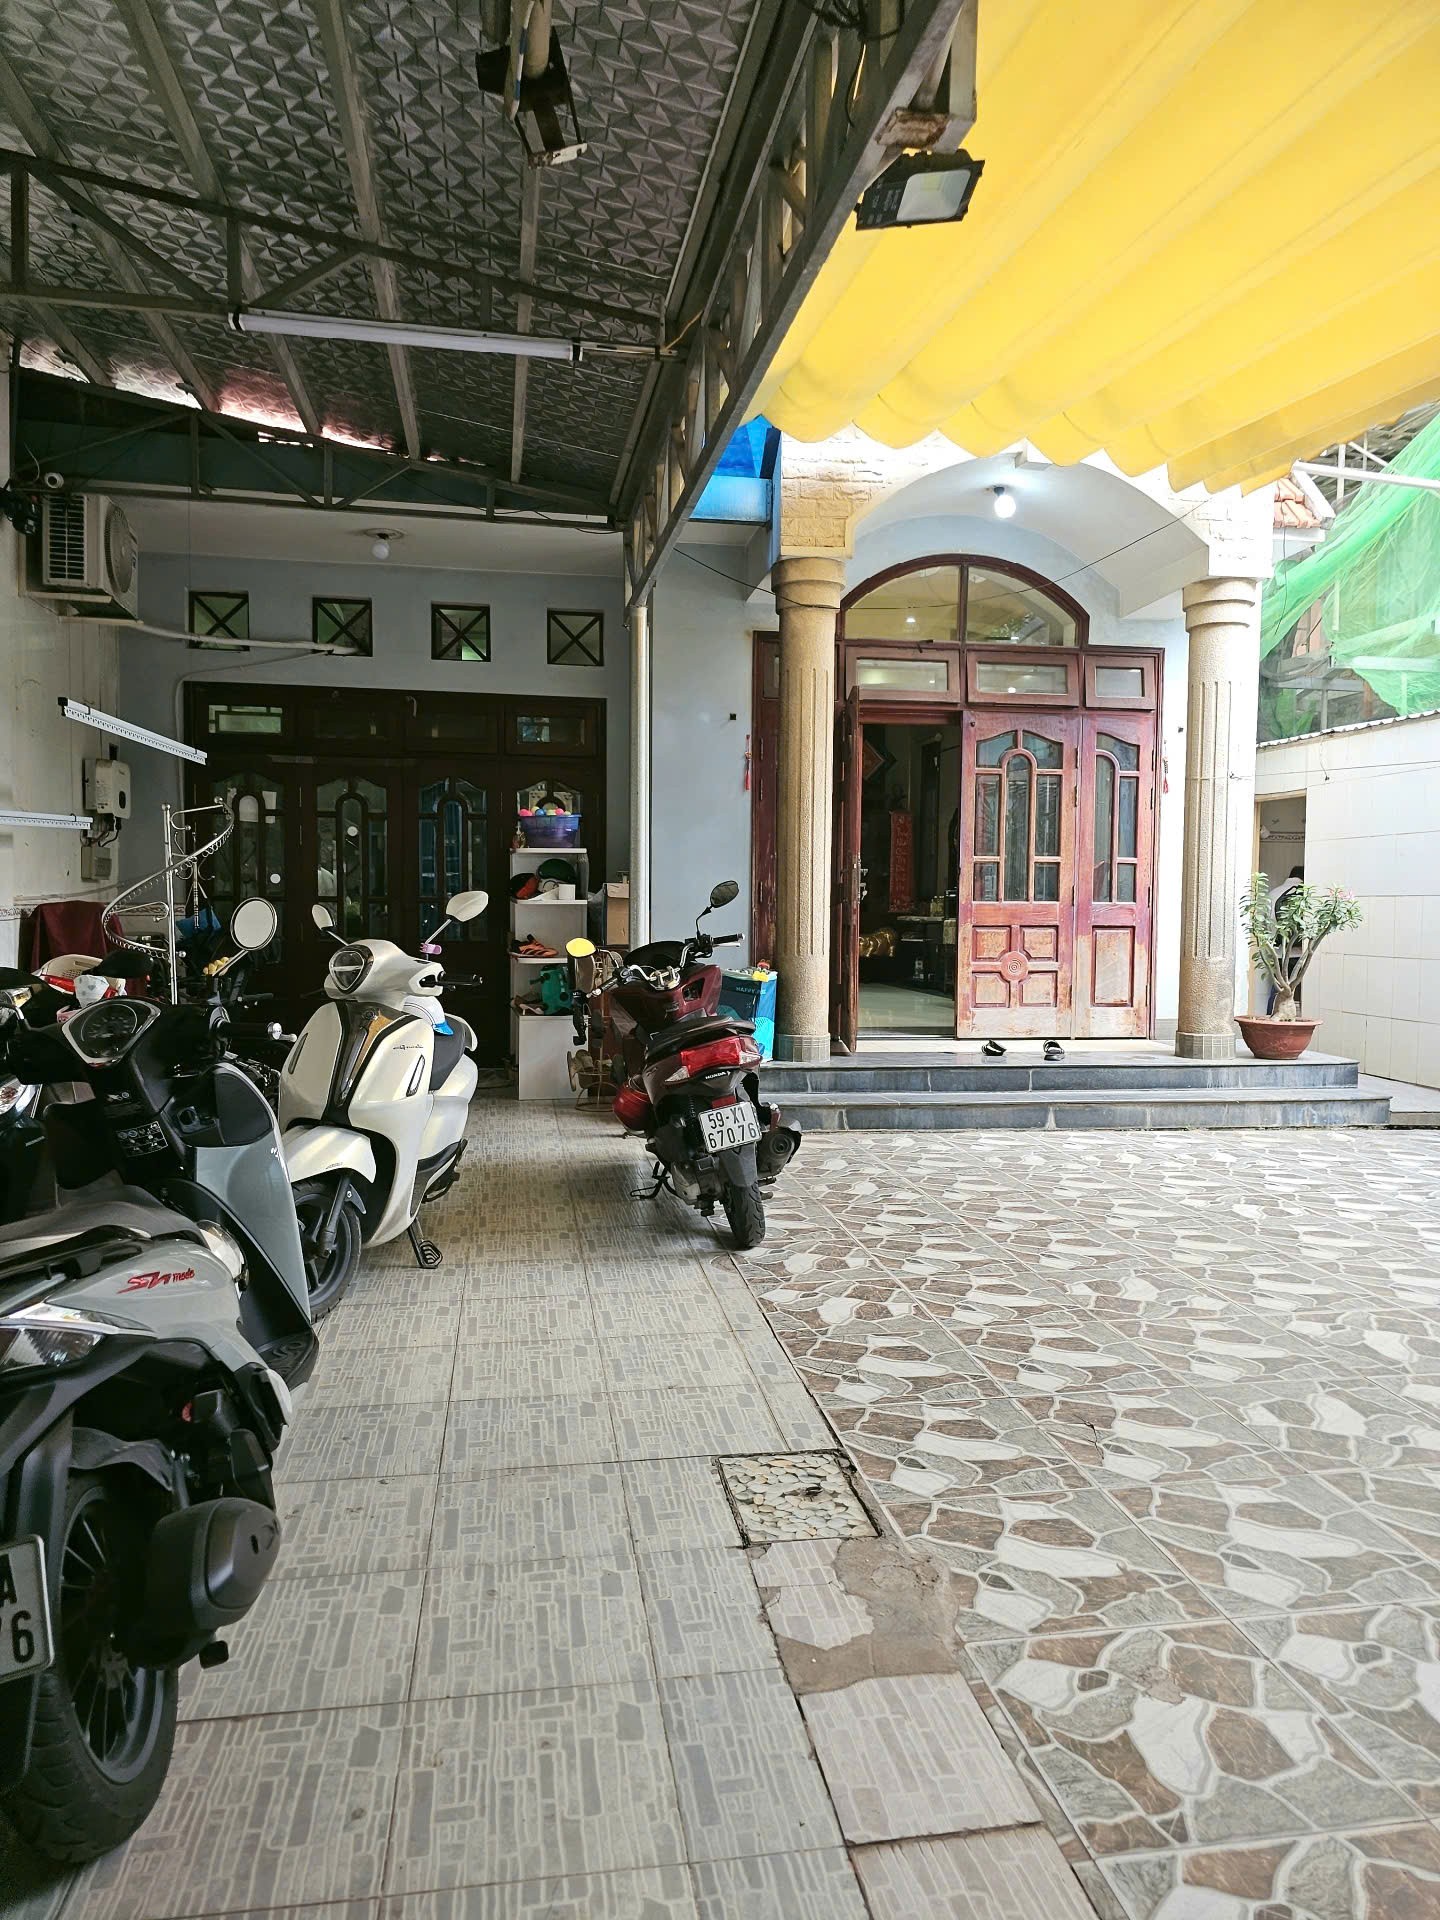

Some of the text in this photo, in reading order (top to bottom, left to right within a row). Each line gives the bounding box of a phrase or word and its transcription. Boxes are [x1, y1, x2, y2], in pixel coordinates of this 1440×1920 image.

[705, 1071, 727, 1080] HONDA
[707, 1107, 746, 1130] 59-X1
[707, 1122, 757, 1149] 670.76
[172, 1267, 196, 1283] mode
